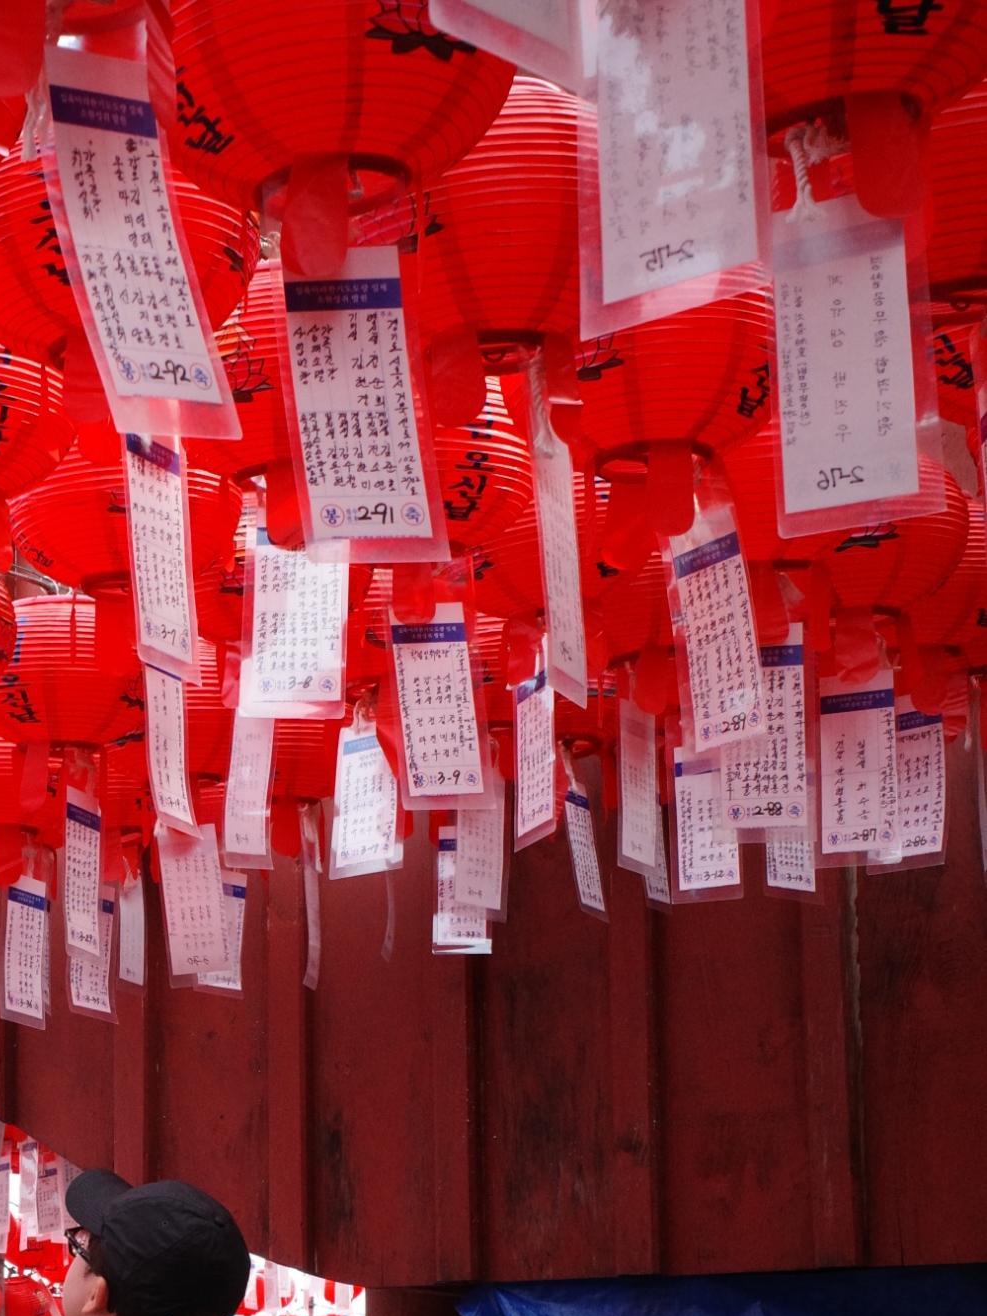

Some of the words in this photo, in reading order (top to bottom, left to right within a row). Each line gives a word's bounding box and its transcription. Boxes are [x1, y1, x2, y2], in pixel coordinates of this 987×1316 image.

[149, 359, 192, 386] 2-92
[443, 450, 496, 522] 오신날
[324, 508, 341, 525] 봉
[357, 502, 394, 525] 2-91
[160, 623, 176, 647] 3-7
[288, 675, 313, 690] 3-8
[722, 711, 746, 734] 2-89
[437, 769, 461, 786] 3-9
[730, 804, 742, 819] 봉
[753, 801, 783, 816] 2-88
[829, 833, 841, 845] 봉
[851, 828, 877, 842] 2-87
[905, 835, 928, 847] 2-86
[703, 869, 725, 881] 3-12
